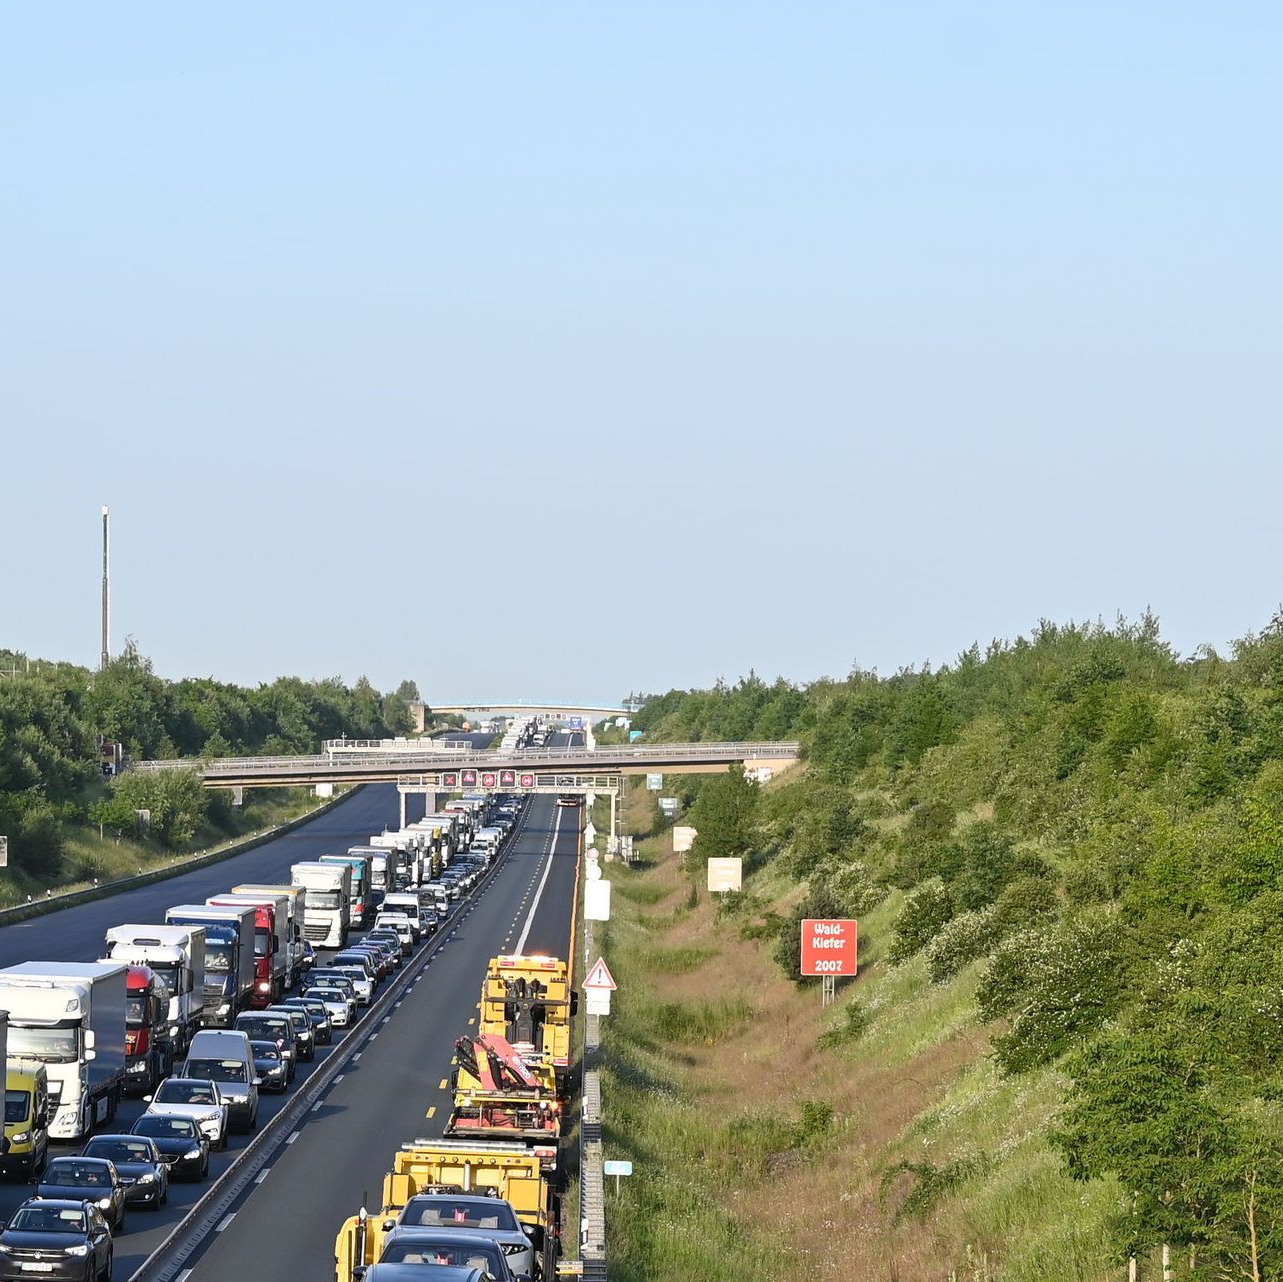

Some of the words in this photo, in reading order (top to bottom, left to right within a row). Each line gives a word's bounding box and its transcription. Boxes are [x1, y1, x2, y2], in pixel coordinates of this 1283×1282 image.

[814, 923, 845, 935] Wald-
[812, 937, 846, 948] Kiefer
[815, 960, 843, 972] 2007
